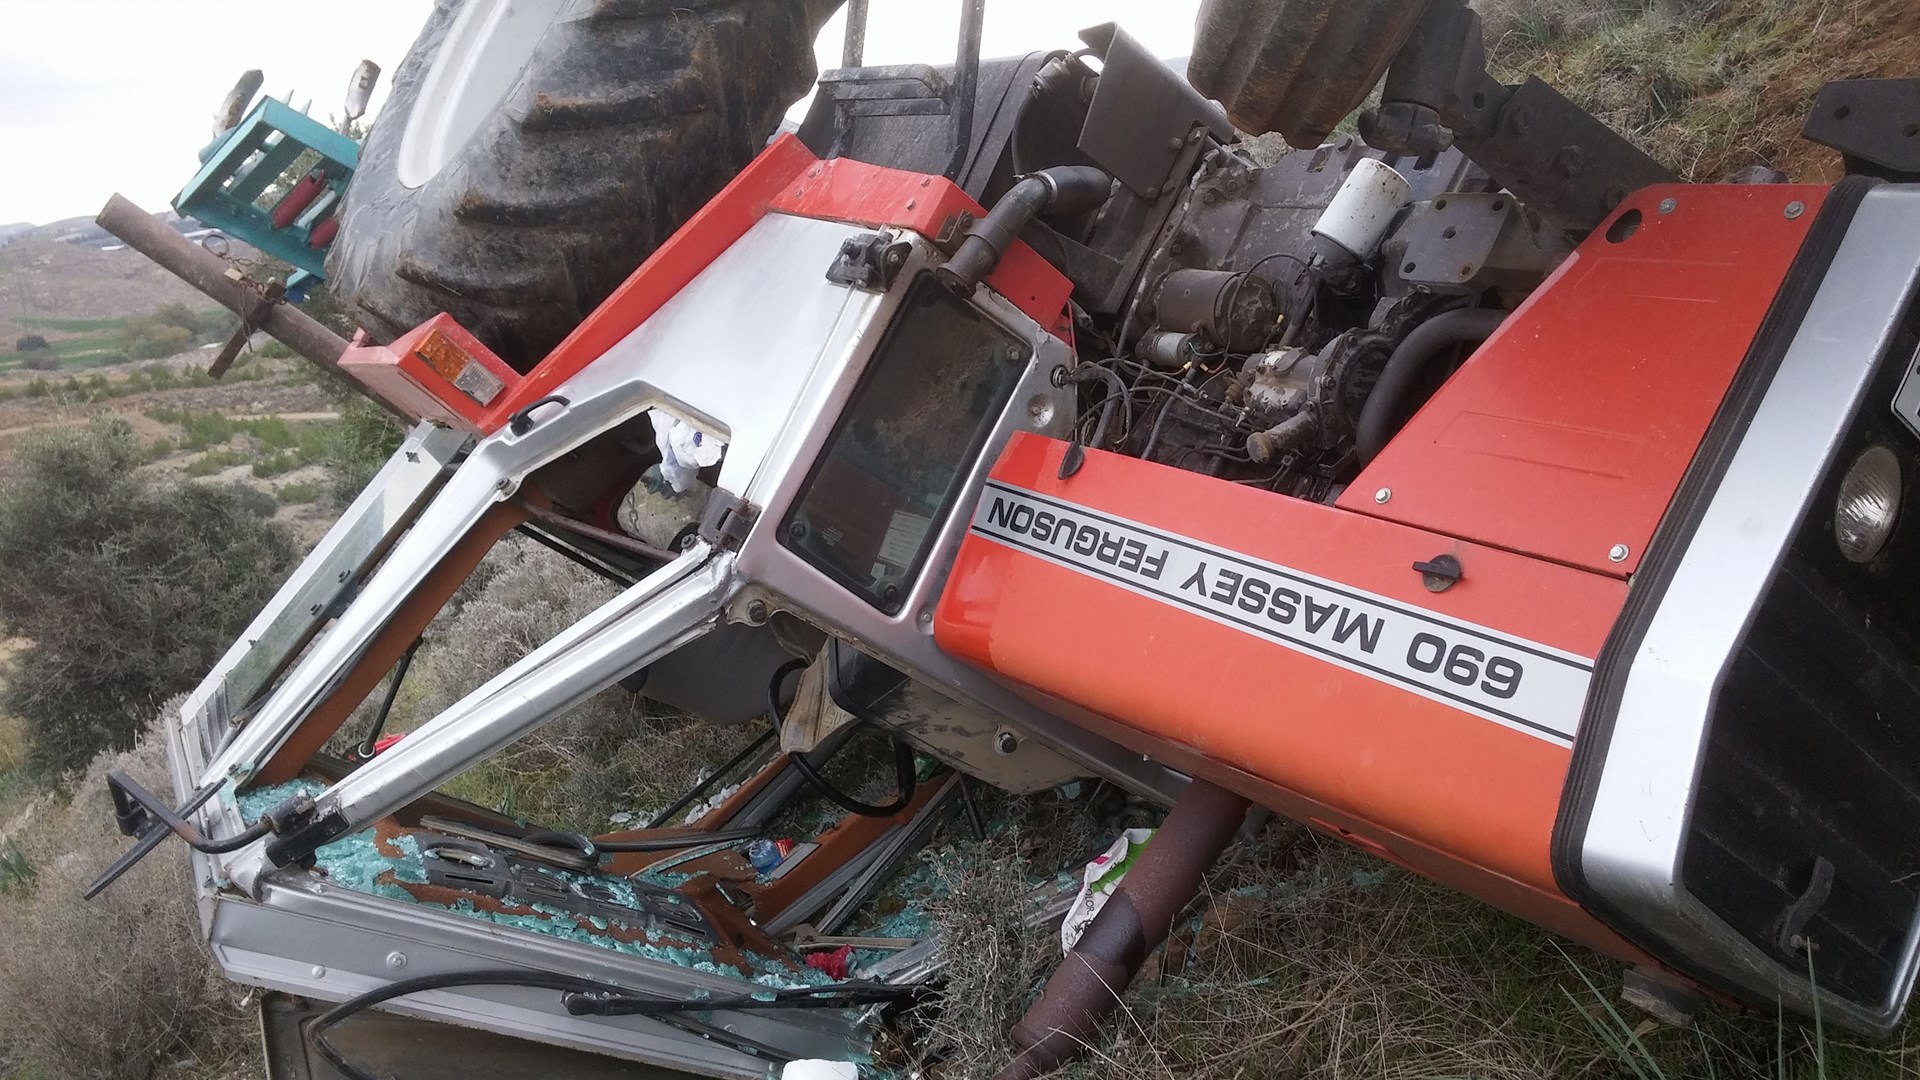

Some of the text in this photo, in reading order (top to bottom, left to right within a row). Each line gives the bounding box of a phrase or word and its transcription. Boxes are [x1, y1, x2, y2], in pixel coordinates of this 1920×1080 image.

[987, 496, 1169, 580] FERGUSON
[1180, 562, 1385, 655] MASSEY
[1406, 631, 1524, 699] 690
